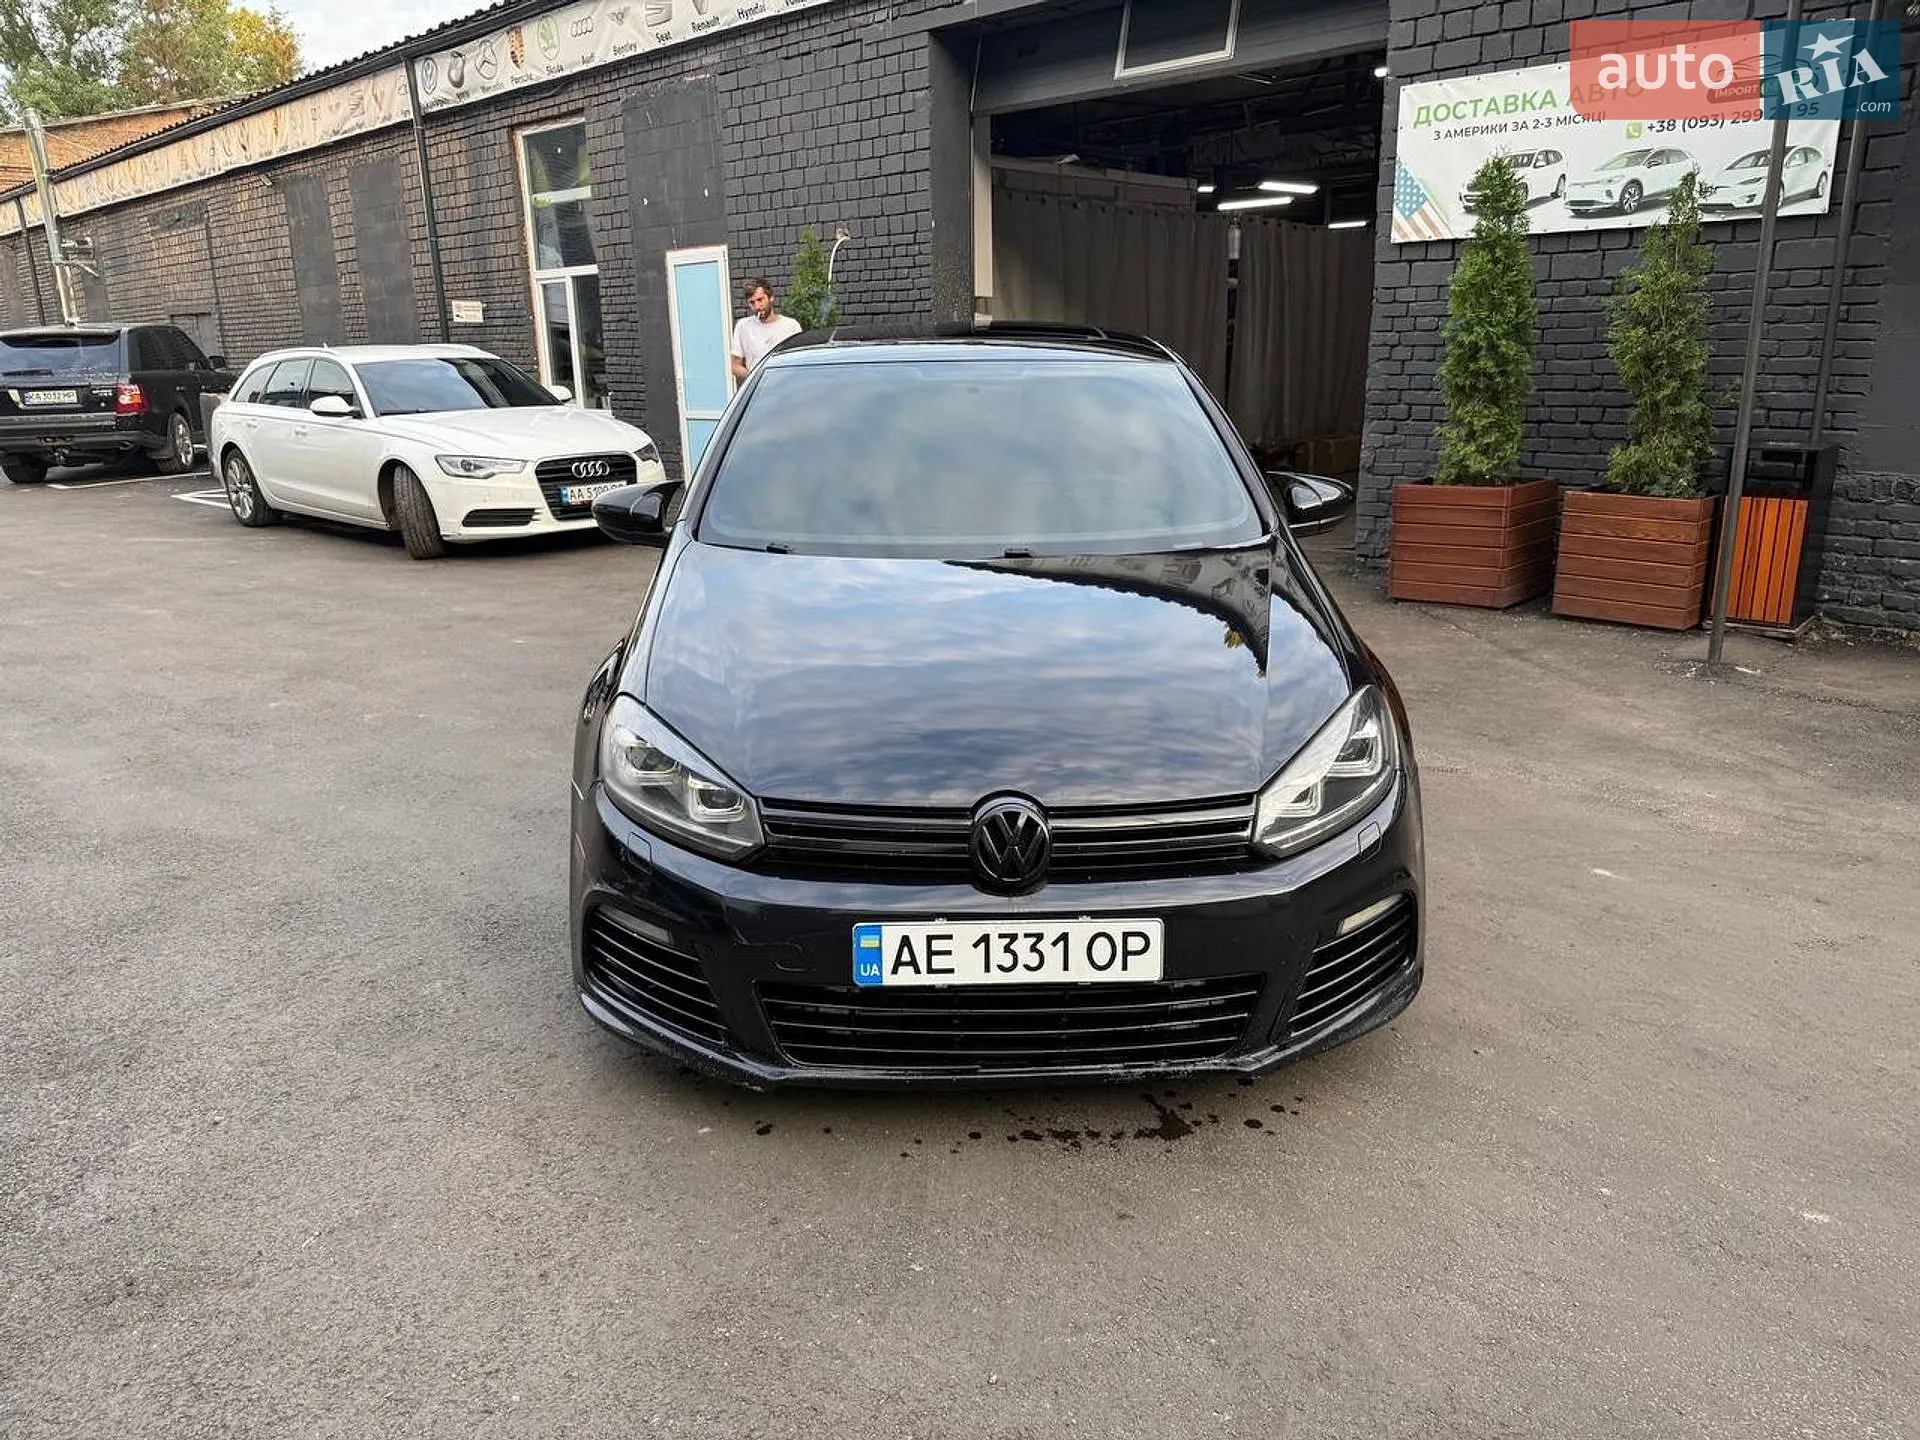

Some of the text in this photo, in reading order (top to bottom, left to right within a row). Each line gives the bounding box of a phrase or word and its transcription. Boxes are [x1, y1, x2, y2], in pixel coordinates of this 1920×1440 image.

[1714, 84, 1759, 99] IMPORT
[1413, 88, 1558, 129] ДОСТАВКА
[1647, 118, 1676, 134] +38
[1681, 113, 1725, 133] (093)
[1730, 107, 1763, 125] 299
[1796, 101, 1820, 117] 95
[1443, 123, 1508, 139] АМЕРИКИ
[1532, 117, 1552, 130] 2-3
[860, 931, 1151, 976] UA AE 1331 OP
